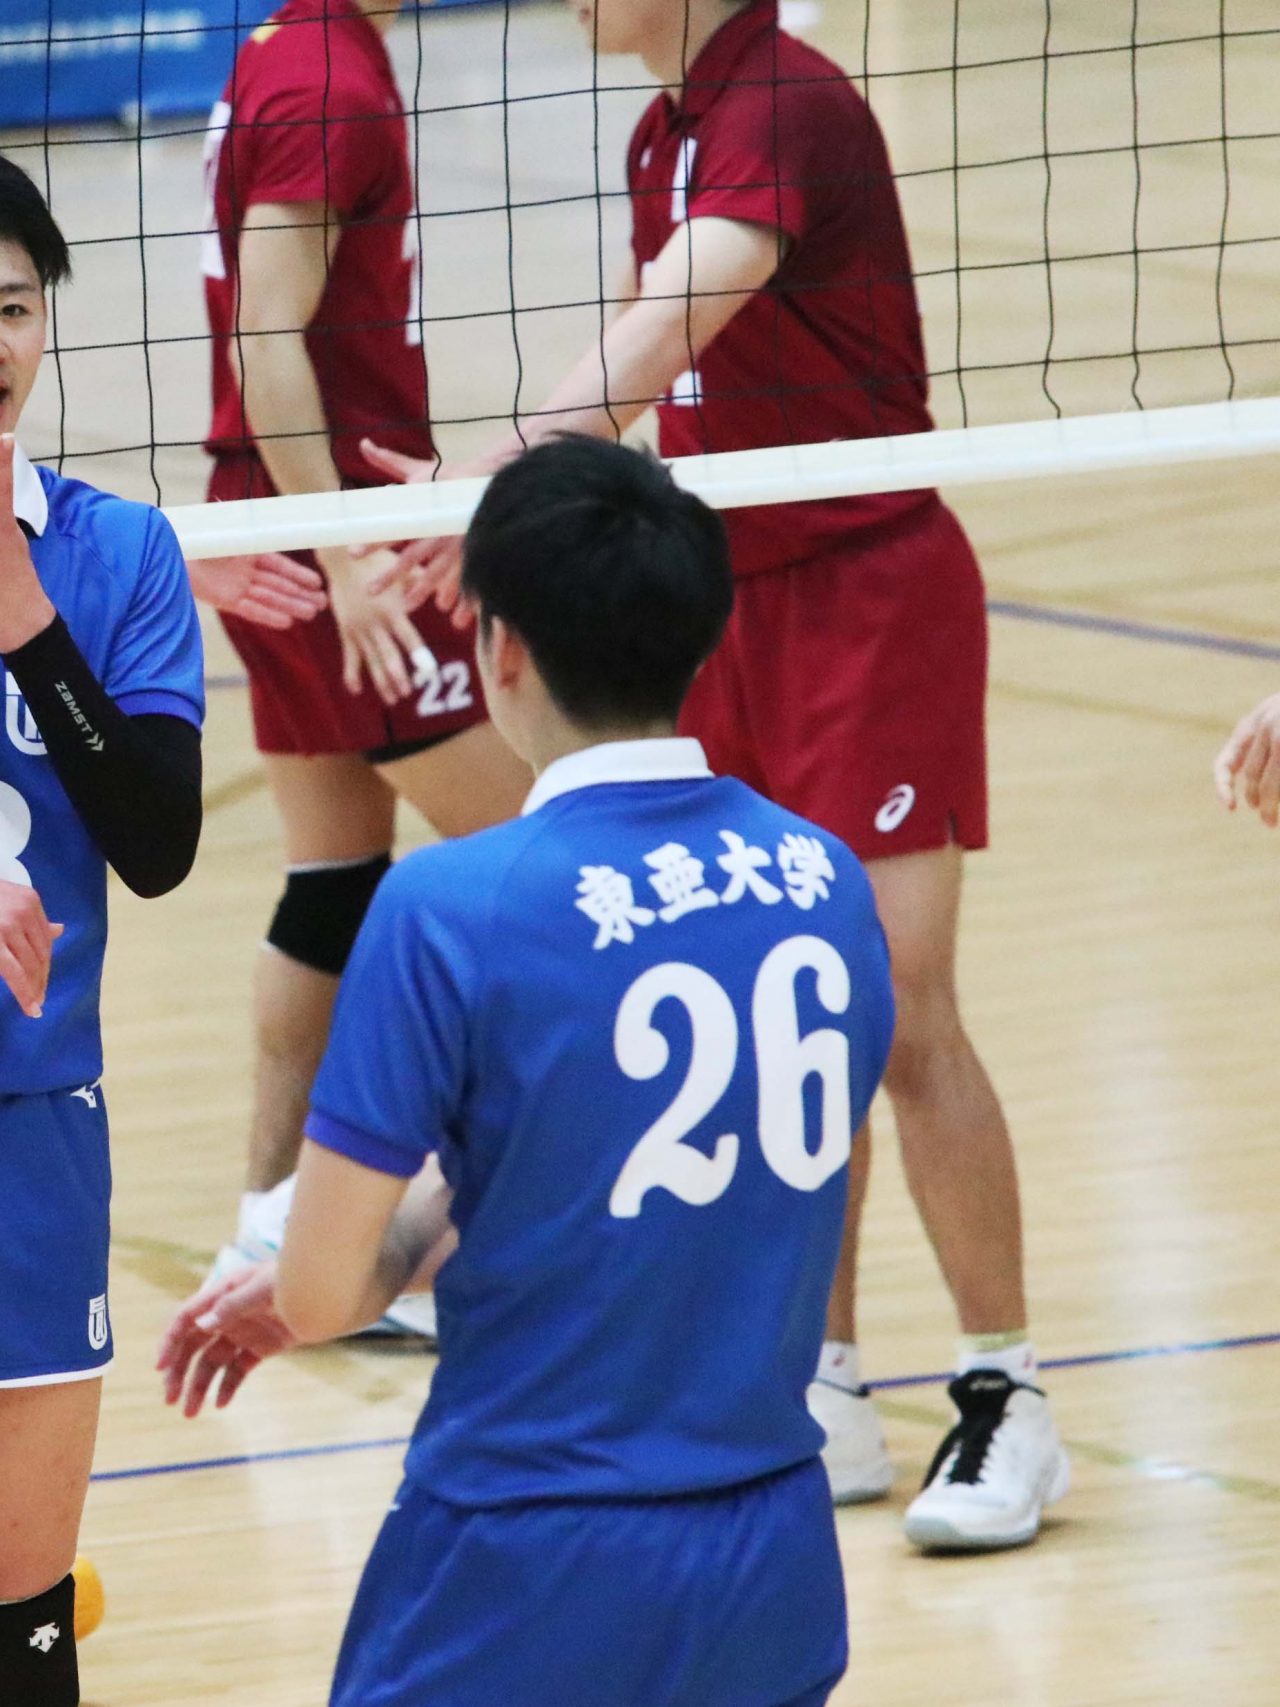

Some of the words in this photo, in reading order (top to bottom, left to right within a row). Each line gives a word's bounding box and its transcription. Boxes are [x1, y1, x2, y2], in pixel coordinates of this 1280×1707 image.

[413, 660, 474, 717] 22
[575, 829, 836, 951] 東亜大学
[608, 934, 852, 1219] 26
